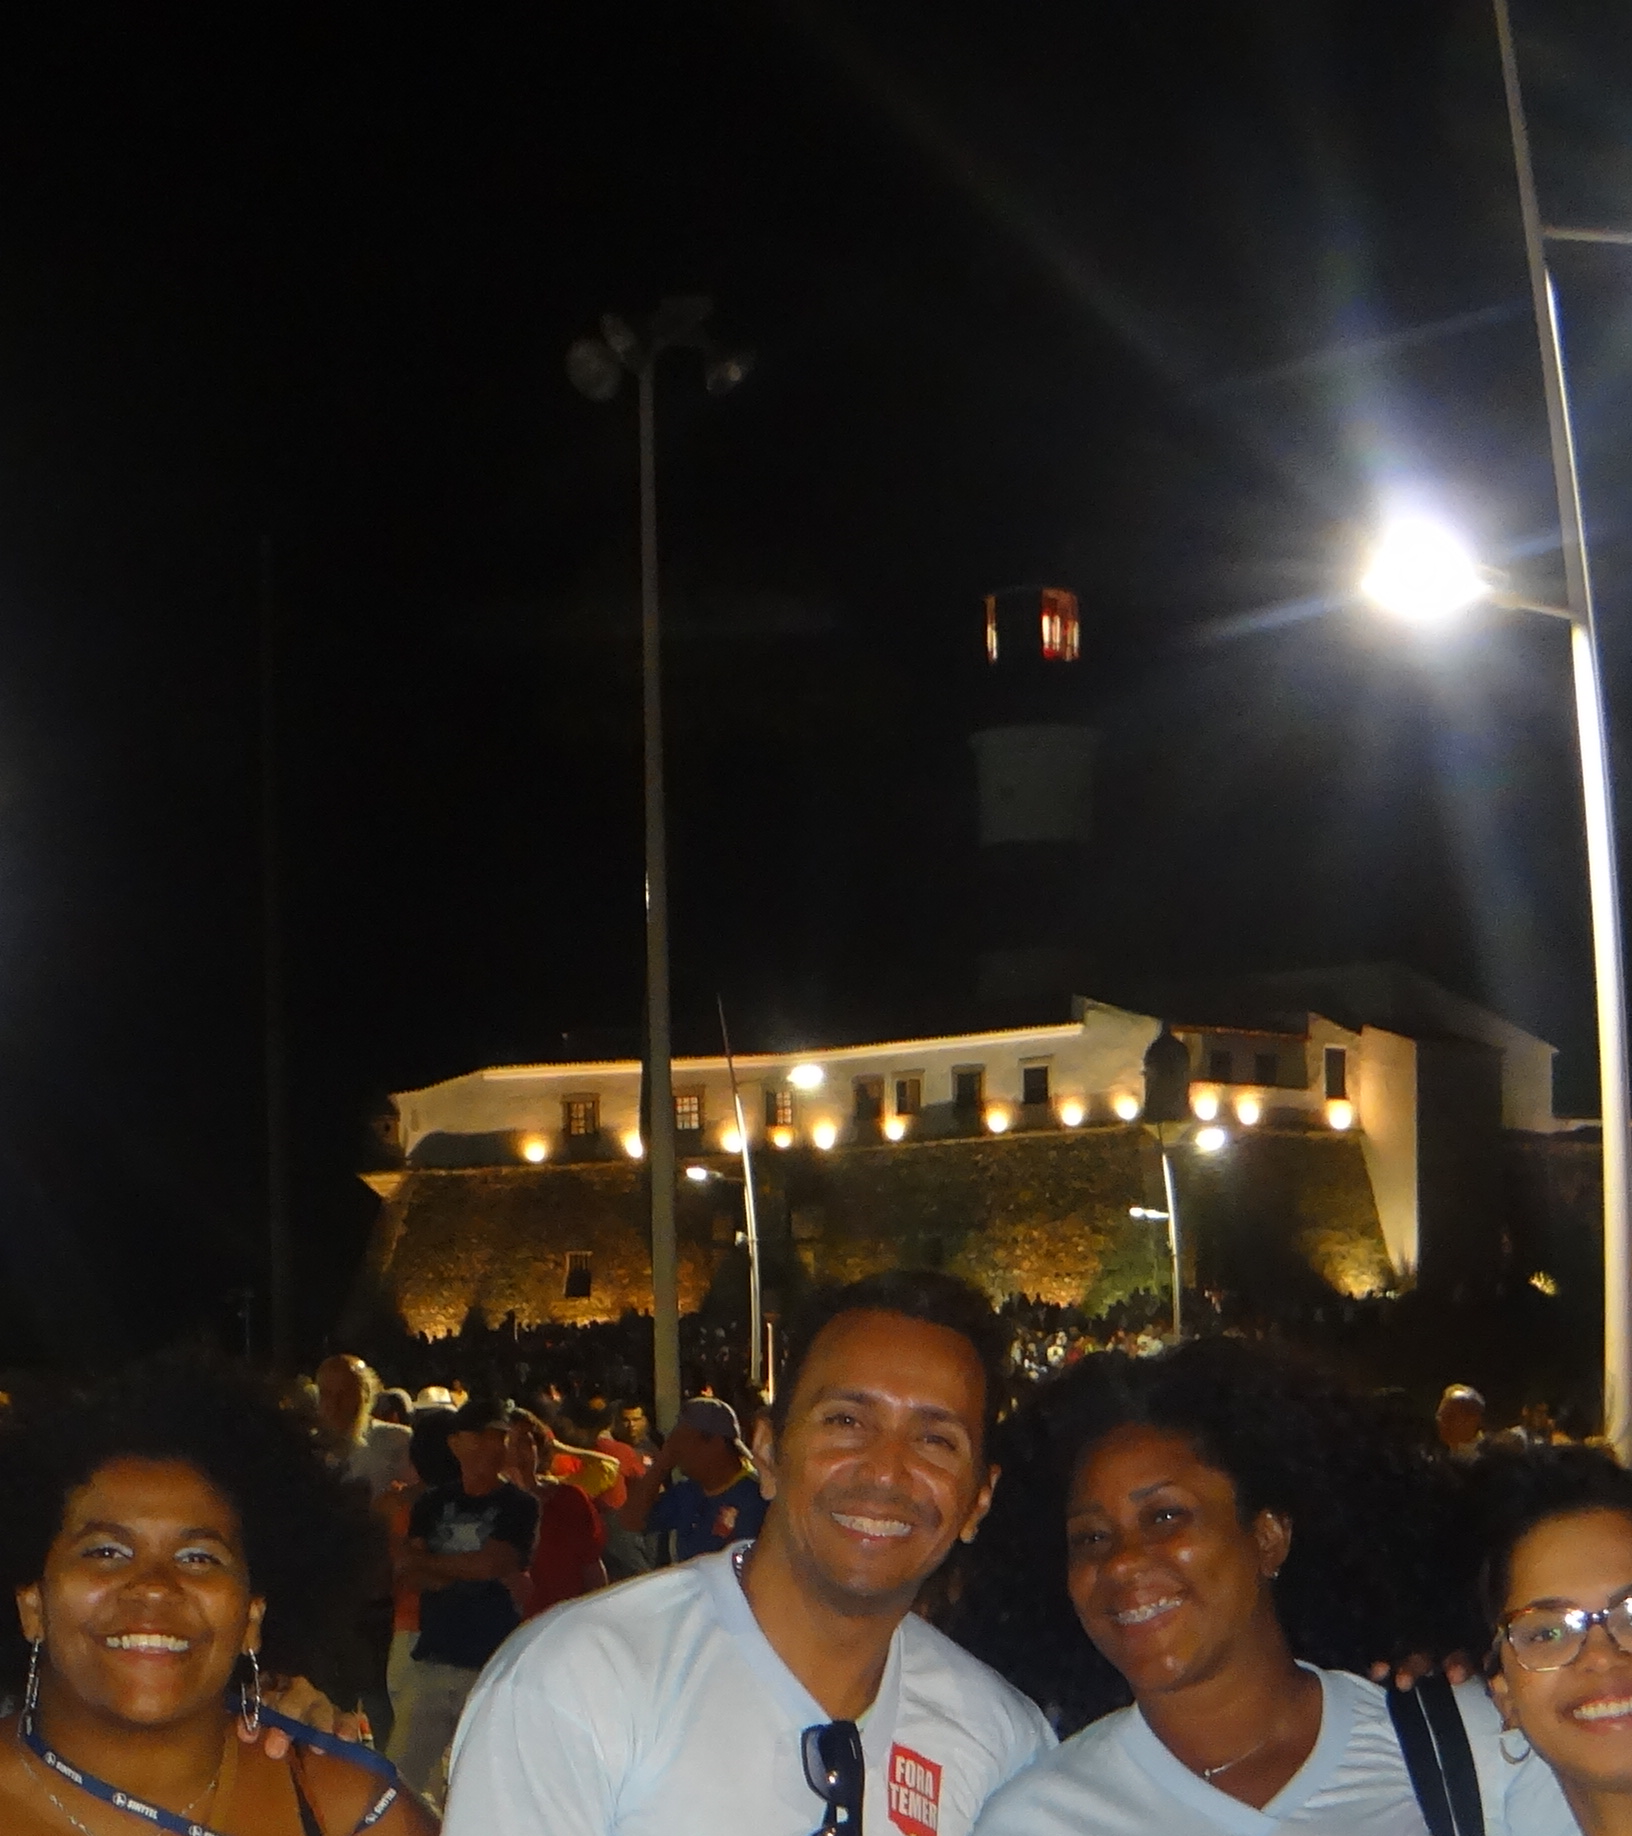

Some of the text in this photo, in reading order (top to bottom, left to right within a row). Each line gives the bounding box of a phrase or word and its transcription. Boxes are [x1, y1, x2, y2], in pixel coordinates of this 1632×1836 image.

[895, 1754, 934, 1800] FORA
[127, 1799, 158, 1820] SINTTEL
[888, 1781, 938, 1831] TEMER
